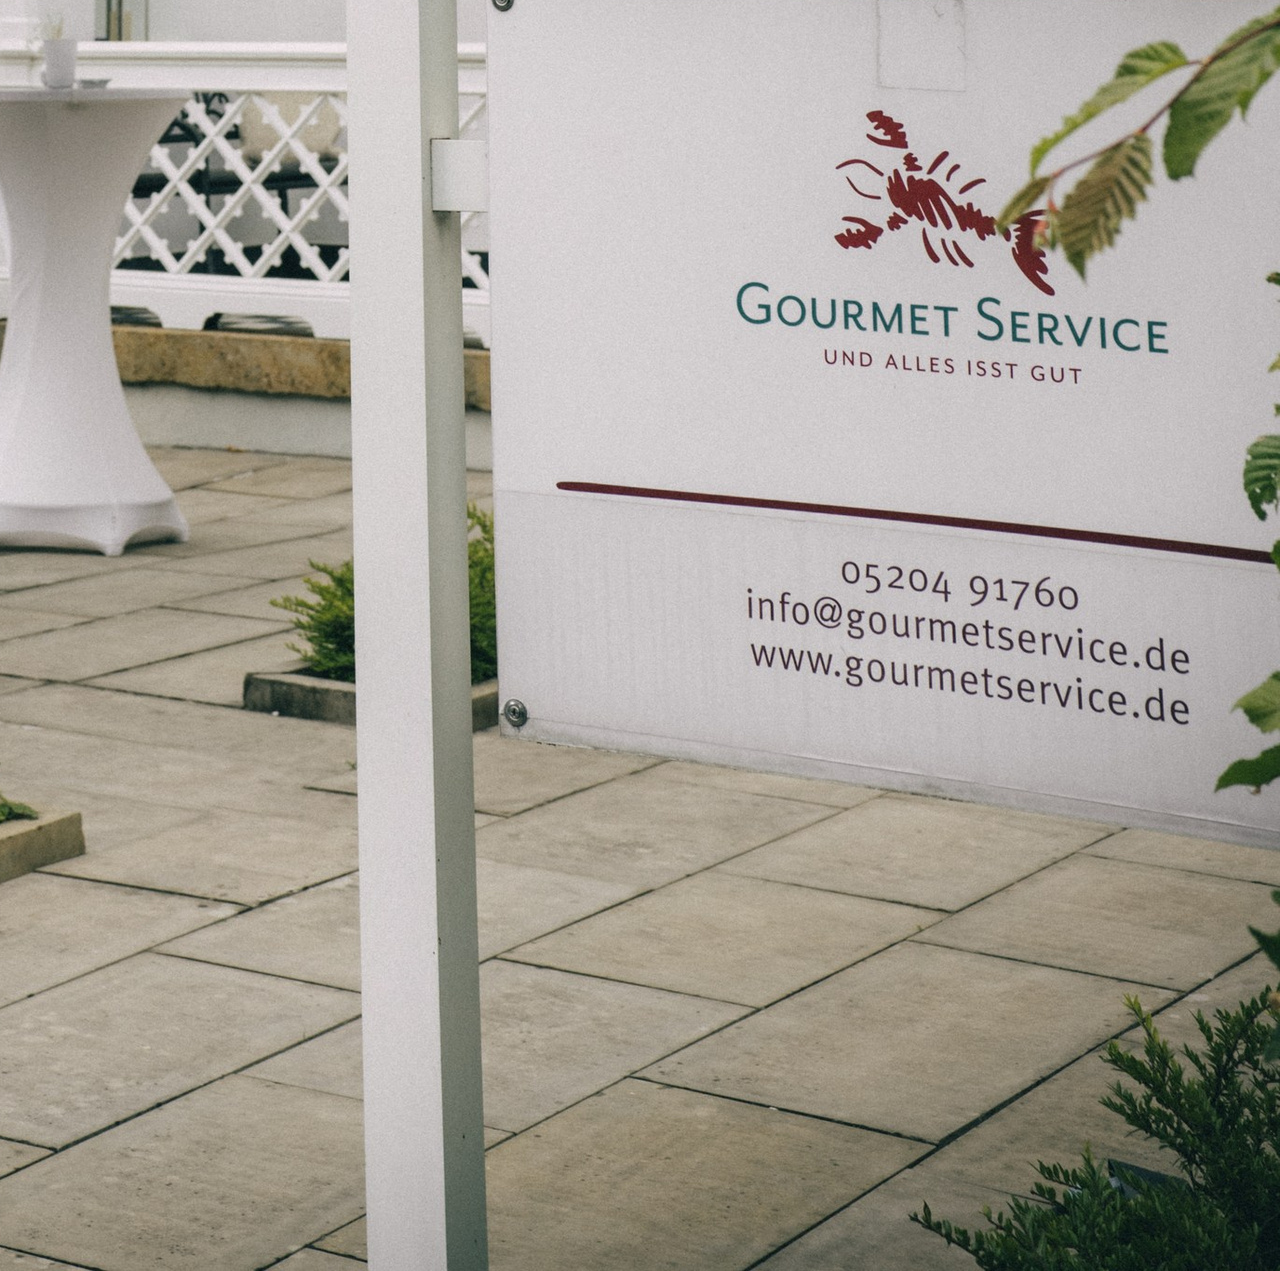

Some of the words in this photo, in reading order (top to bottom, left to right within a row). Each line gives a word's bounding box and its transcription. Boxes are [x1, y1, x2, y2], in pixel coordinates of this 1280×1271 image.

[736, 281, 959, 337] GOURMET
[976, 296, 1169, 354] SERVICE
[824, 349, 873, 368] UND
[885, 354, 955, 375] ALLES
[967, 360, 1018, 379] ISST
[1030, 364, 1082, 384] GUT
[841, 561, 951, 603] 05204
[969, 575, 1079, 611] 91760
[747, 588, 1190, 675] info@gourmetservice.de
[750, 643, 1190, 726] www.gourmetservice.de
